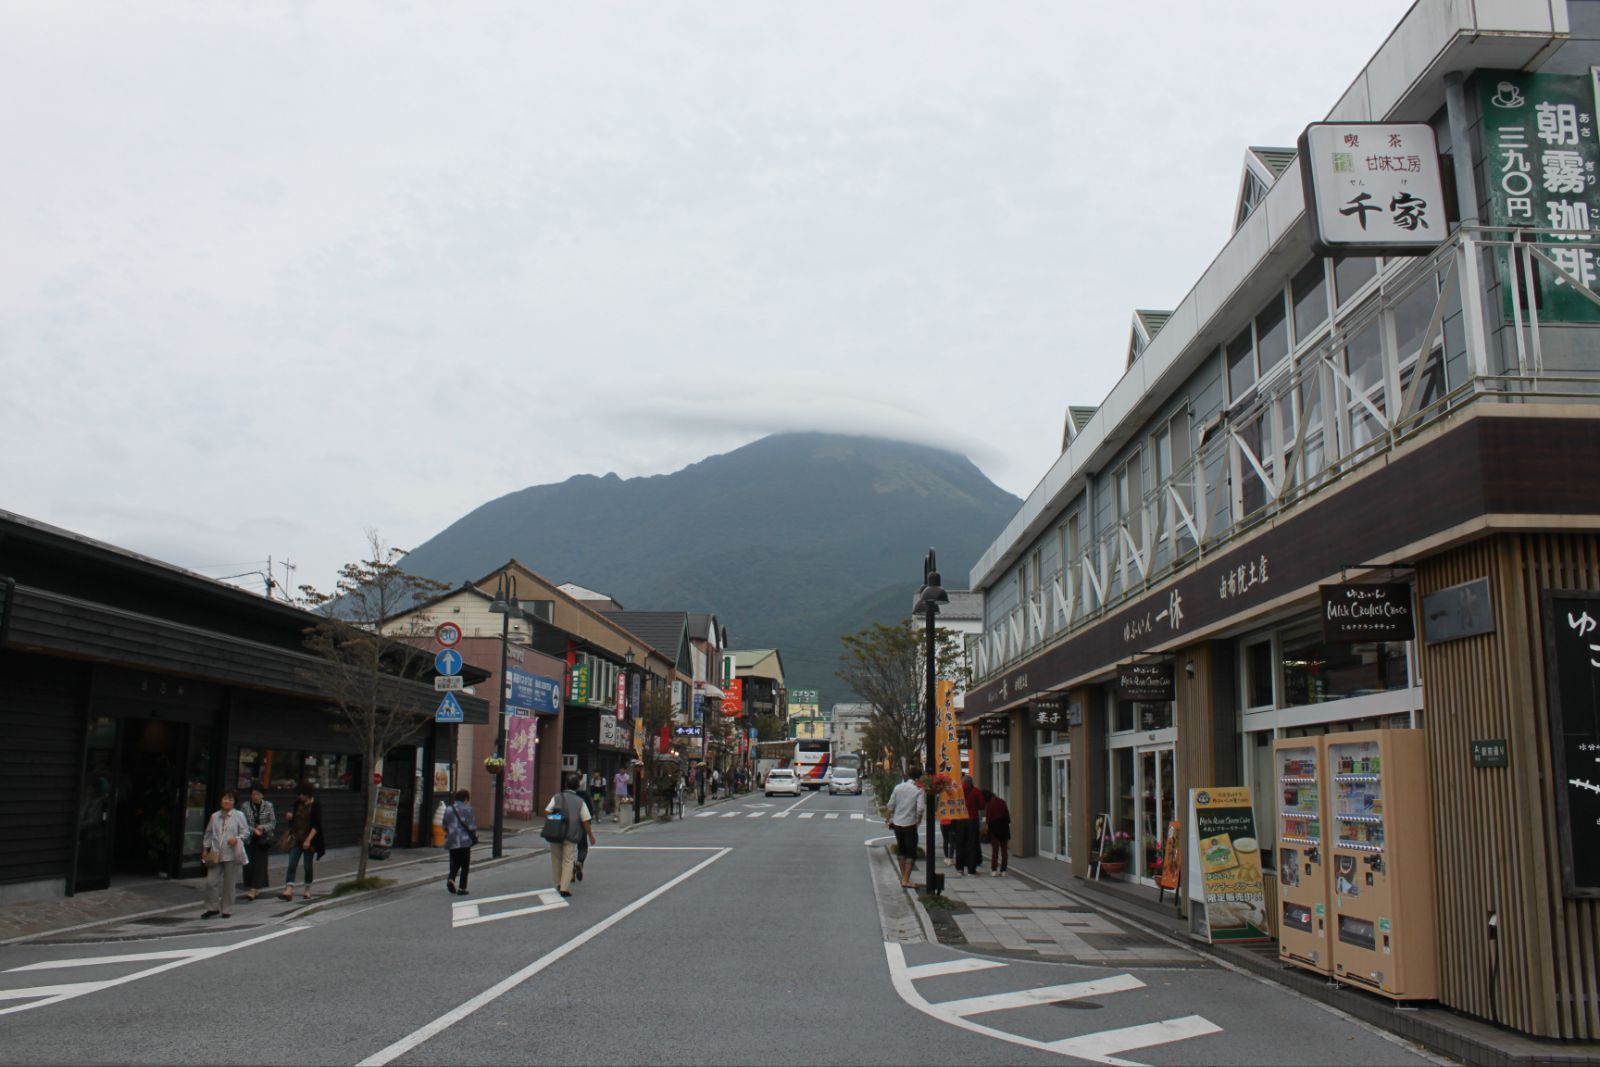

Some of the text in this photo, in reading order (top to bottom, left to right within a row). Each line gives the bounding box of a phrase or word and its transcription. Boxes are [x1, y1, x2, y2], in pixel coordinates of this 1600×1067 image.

[1366, 154, 1421, 172] 甘味工房
[1339, 192, 1430, 231] 千家
[1535, 101, 1597, 290] 朝霧珈琲
[1155, 588, 1184, 630] 一休
[1219, 554, 1270, 600] 由布院土産
